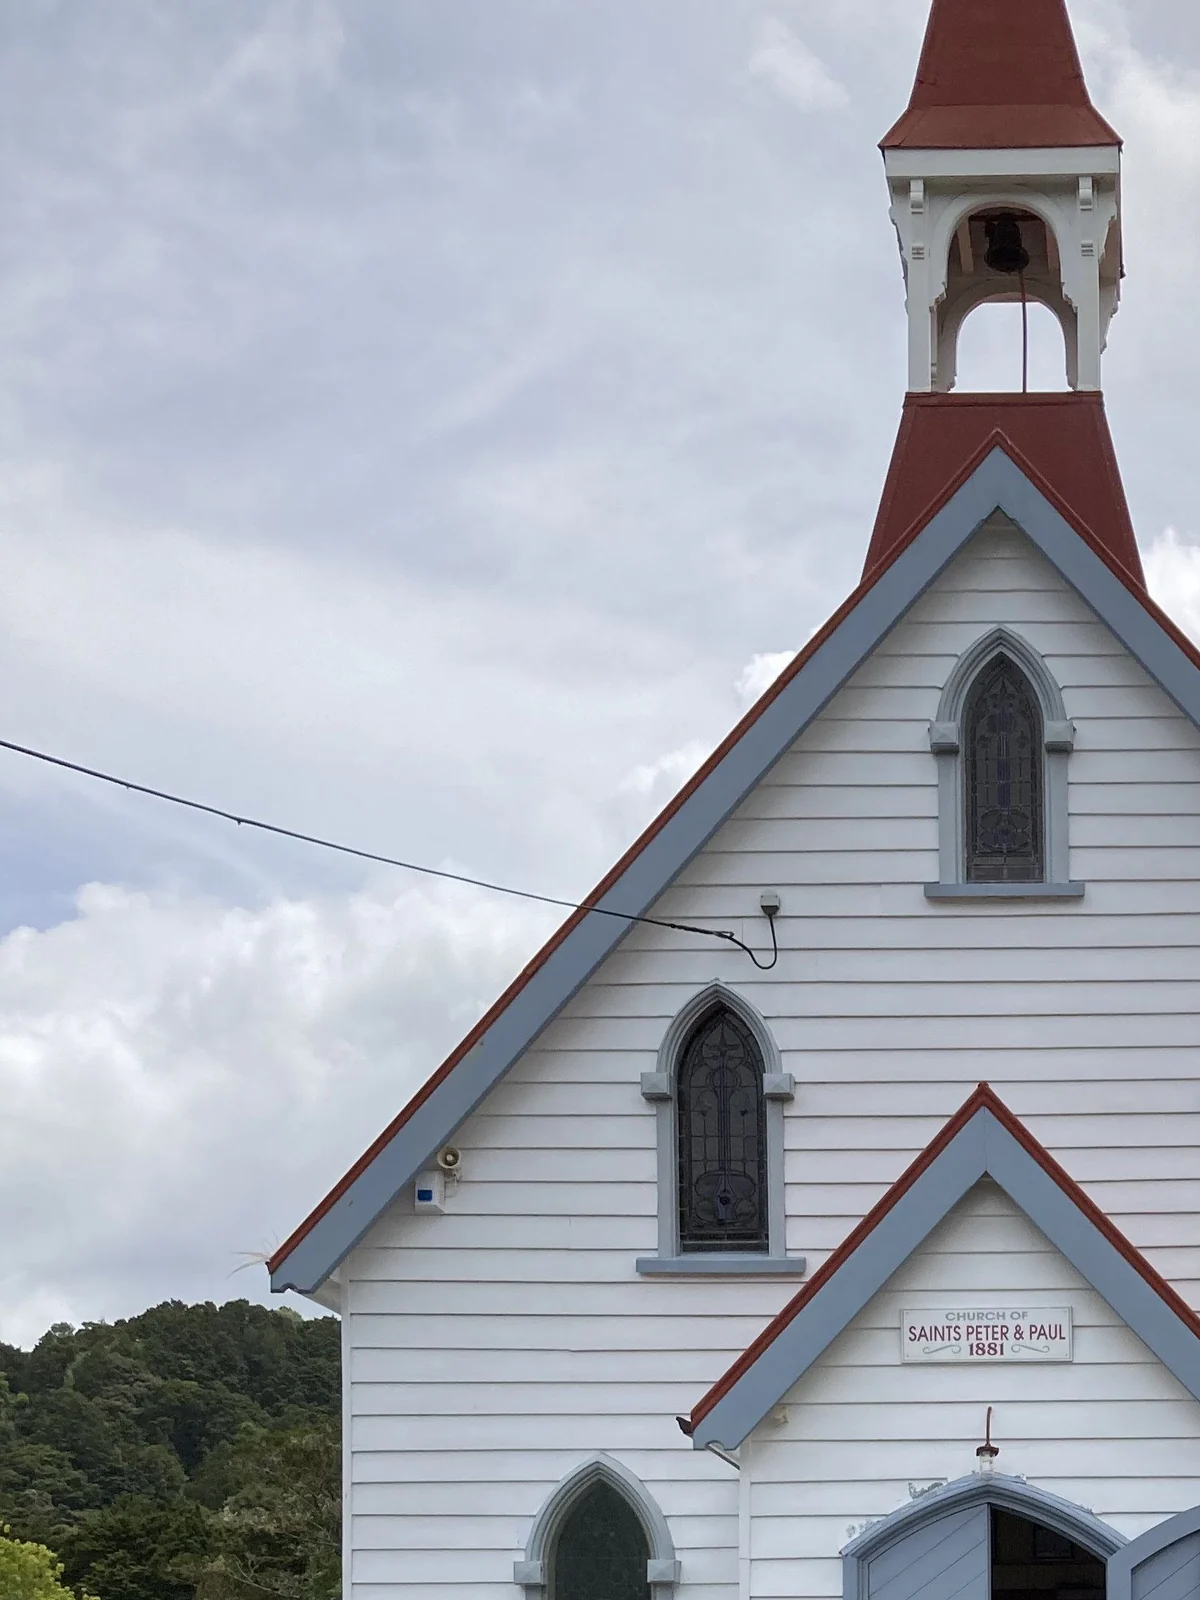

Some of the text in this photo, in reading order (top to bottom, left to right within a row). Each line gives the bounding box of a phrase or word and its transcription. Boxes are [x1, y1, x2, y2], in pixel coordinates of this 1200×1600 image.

[945, 1311, 1028, 1321] CHURCH OF
[908, 1324, 1066, 1342] SAINTS PETER & PAUL
[968, 1342, 1005, 1356] 1881
